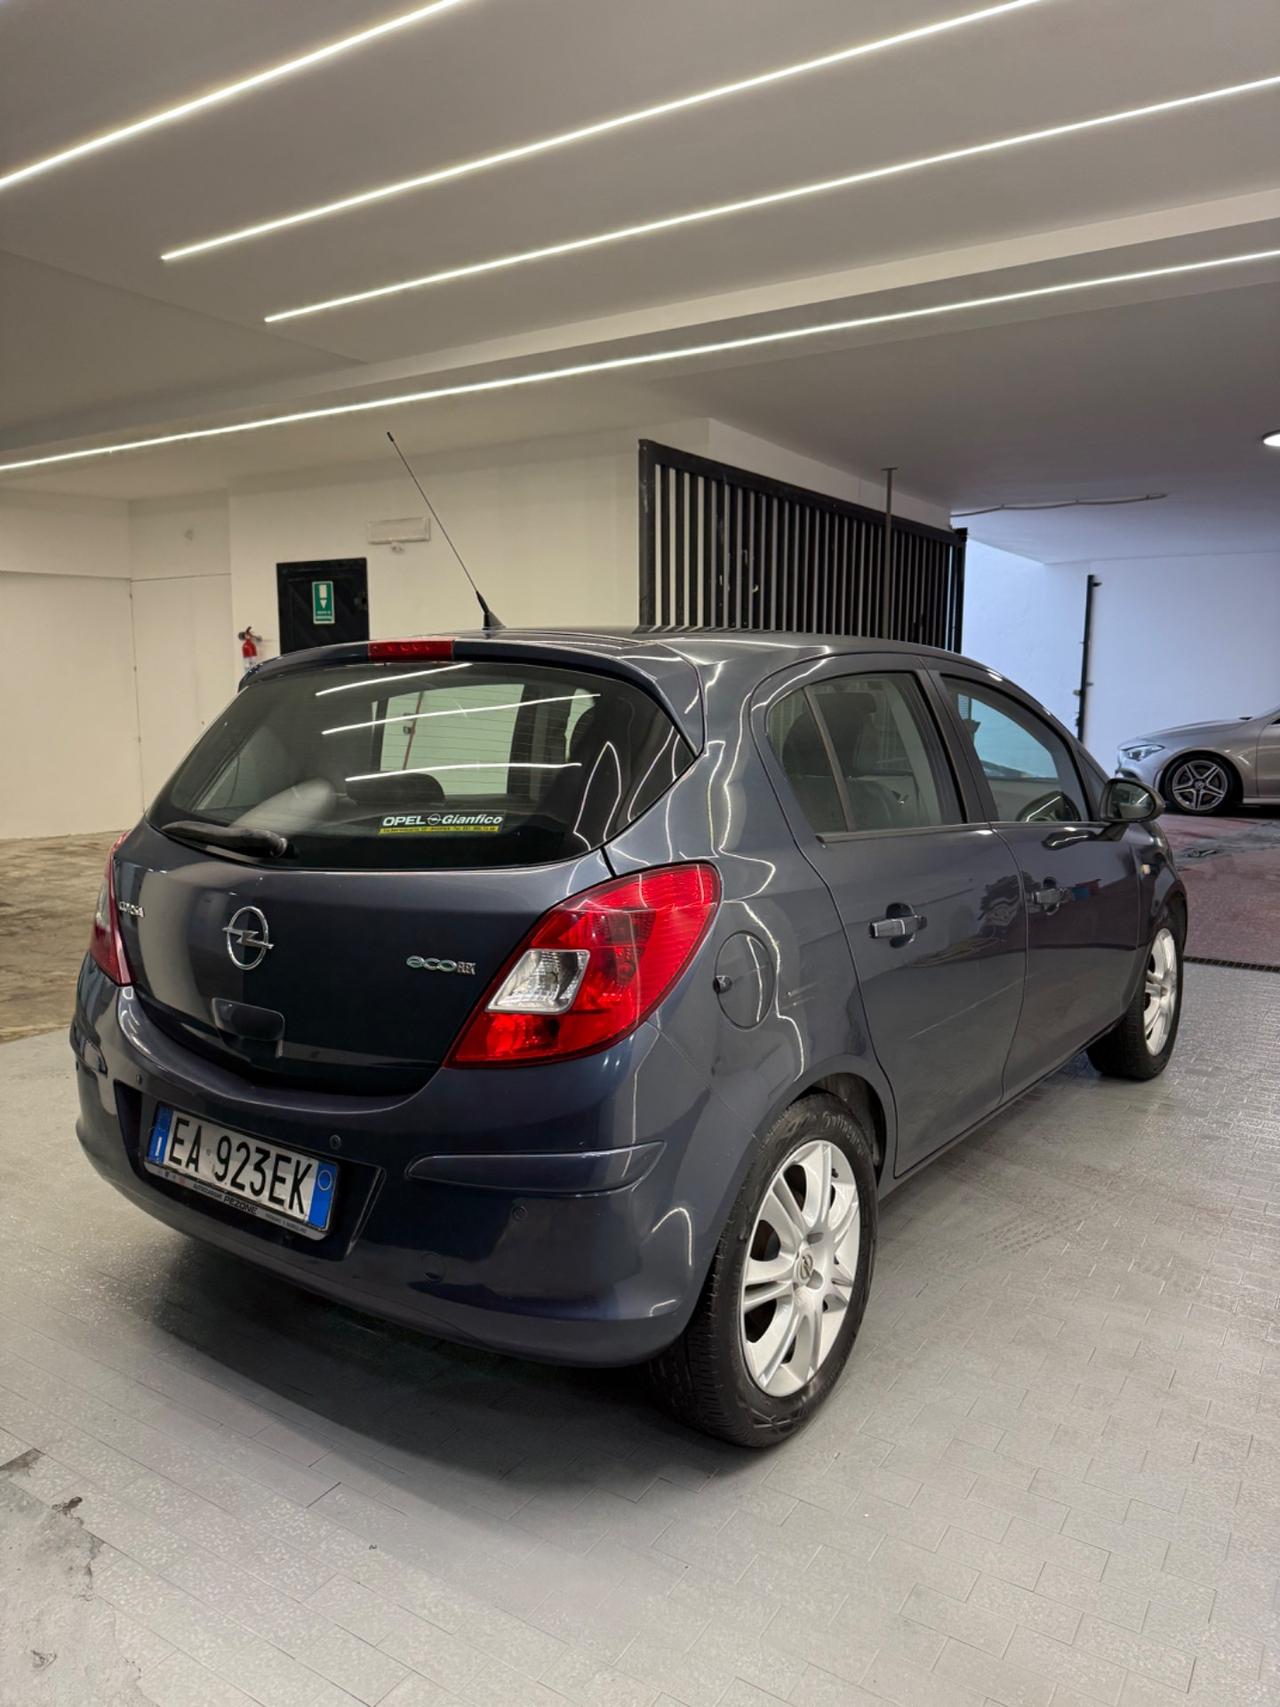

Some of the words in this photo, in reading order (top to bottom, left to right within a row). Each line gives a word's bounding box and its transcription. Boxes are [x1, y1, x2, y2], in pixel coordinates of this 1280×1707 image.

[382, 815, 426, 827] OPEL
[441, 813, 503, 825] Gianfico
[168, 1117, 203, 1173] EA
[214, 1135, 313, 1215] 923EK
[223, 1195, 258, 1215] PEZONE
